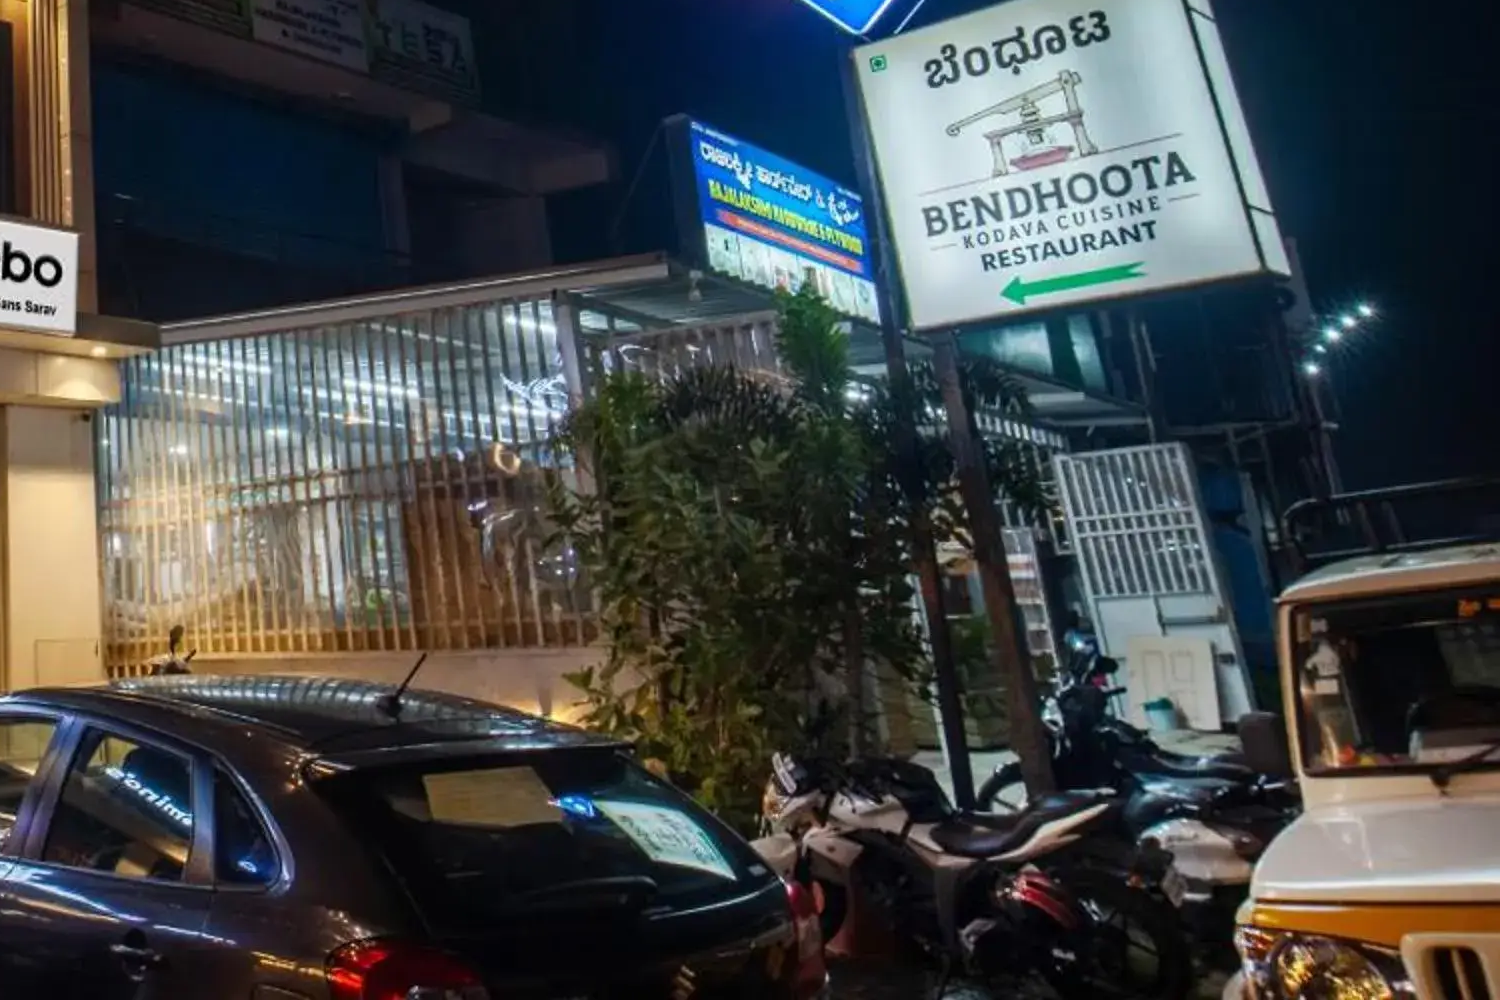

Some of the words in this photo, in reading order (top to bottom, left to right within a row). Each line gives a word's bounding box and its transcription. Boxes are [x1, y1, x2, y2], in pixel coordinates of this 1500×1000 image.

[921, 150, 1196, 237] BENDHOOTA
[963, 220, 1049, 249] KODAVA
[1056, 195, 1163, 232] CUISINE
[981, 220, 1159, 271] RESTAURANT
[24, 300, 58, 318] Sarav
